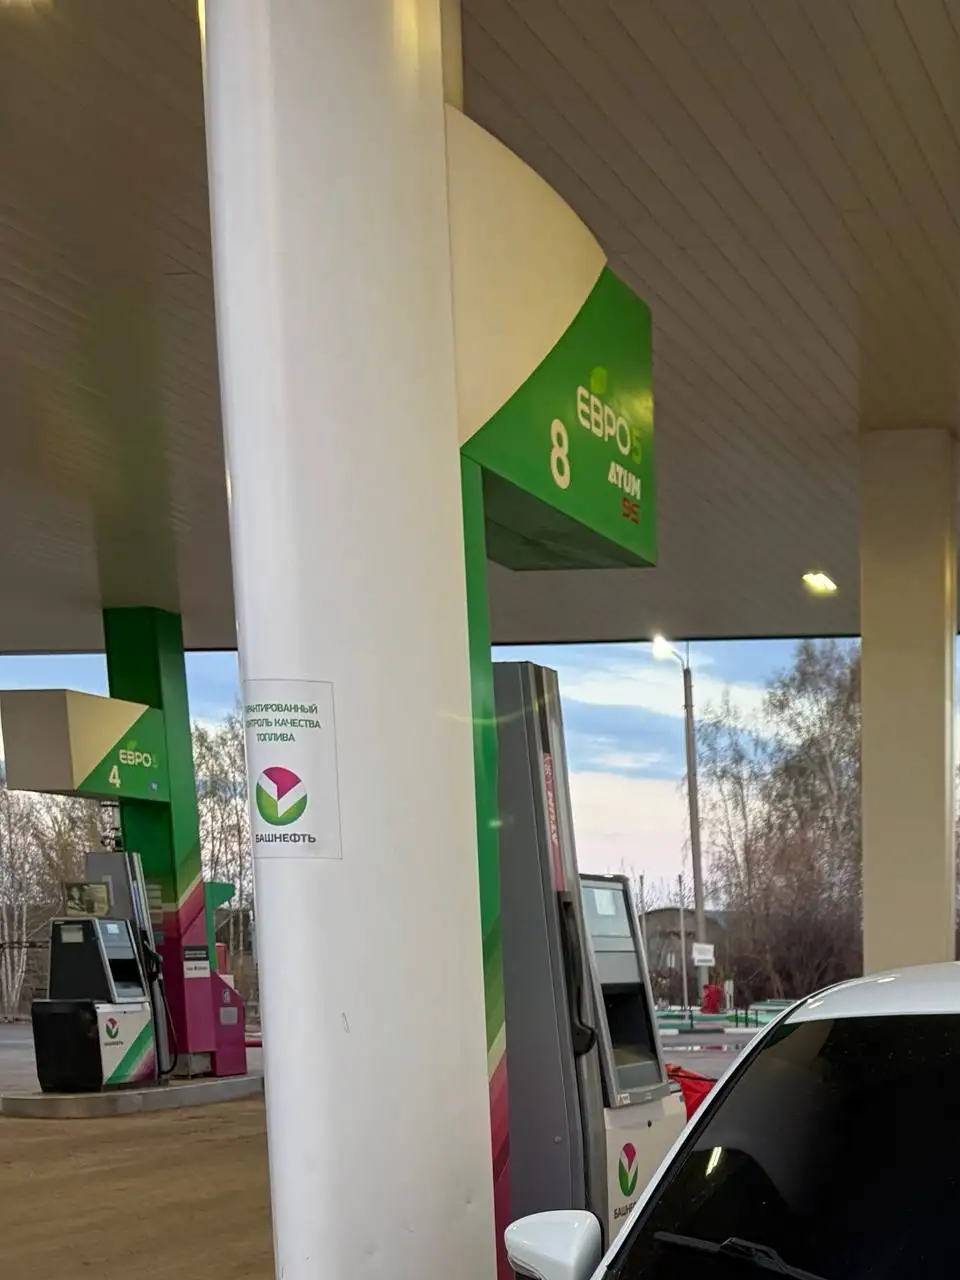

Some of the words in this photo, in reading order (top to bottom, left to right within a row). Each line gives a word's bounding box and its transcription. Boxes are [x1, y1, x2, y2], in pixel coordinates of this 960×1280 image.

[550, 418, 571, 490] 8
[274, 718, 321, 729] КАЧЕСТВА
[256, 732, 296, 742] ТОПЛИВА
[109, 765, 121, 789] 4
[255, 833, 317, 843] БАШНЕФТЬ
